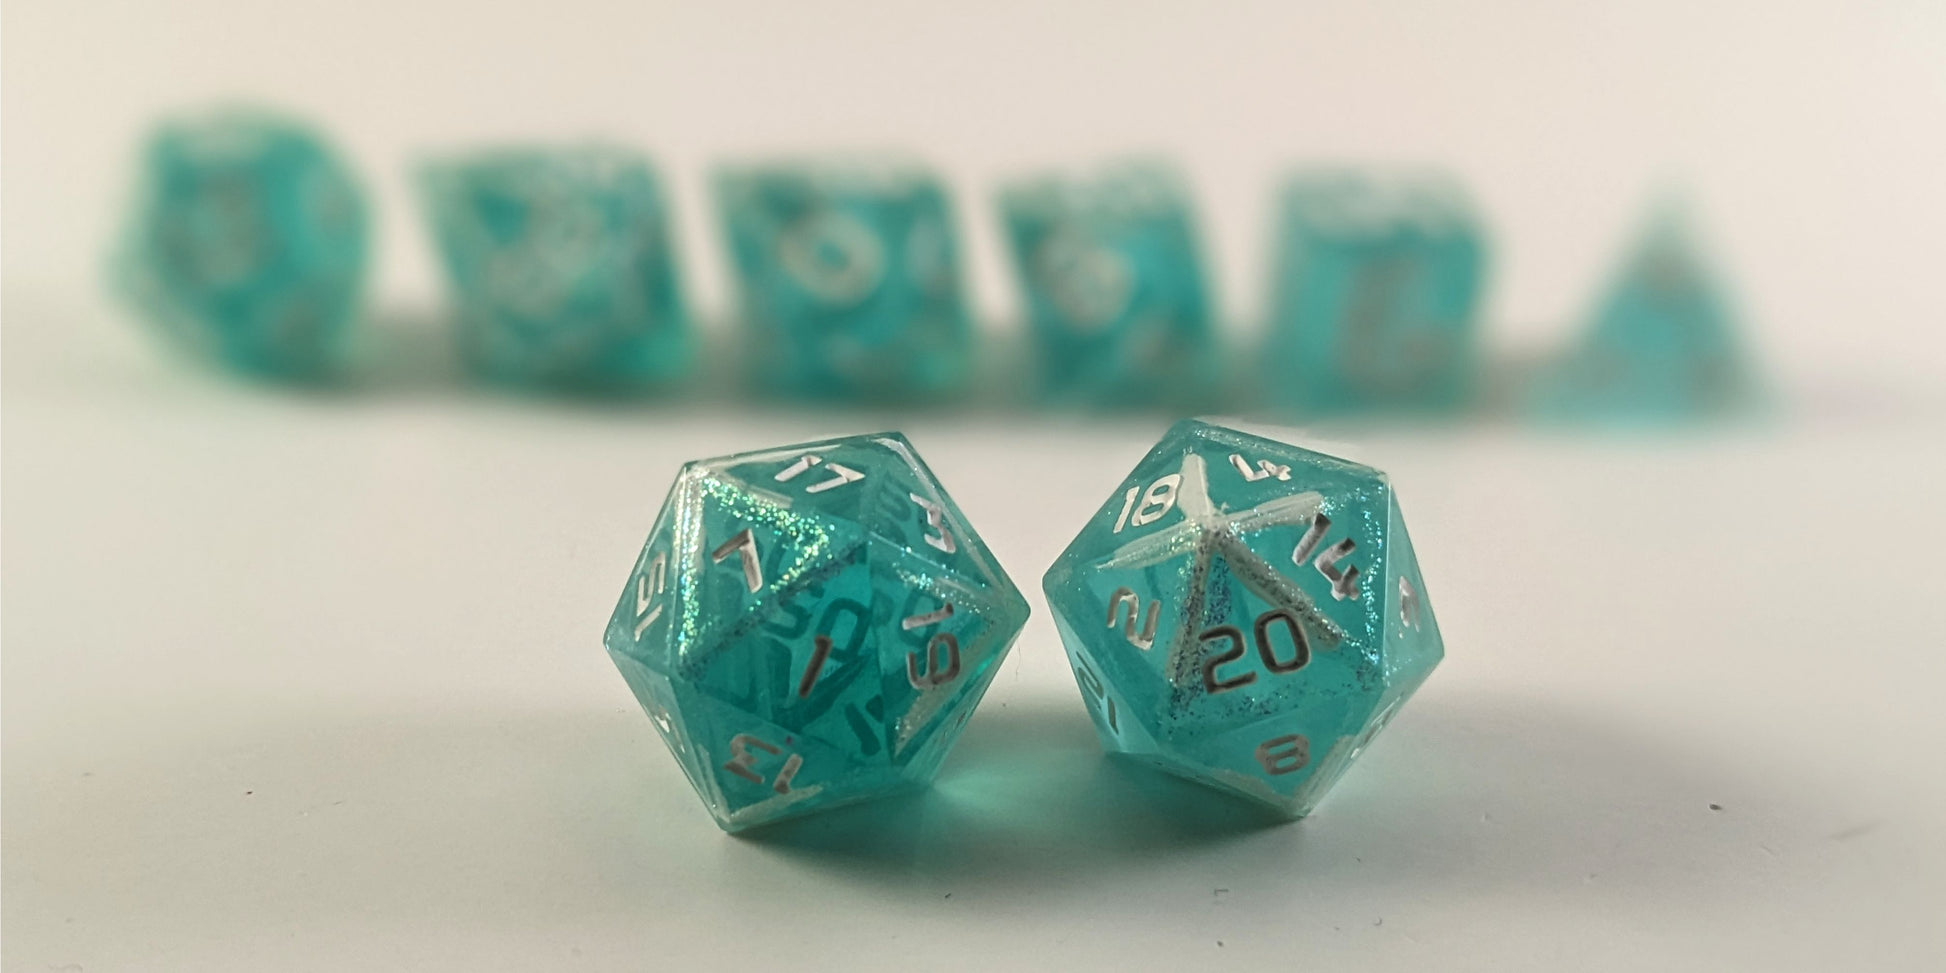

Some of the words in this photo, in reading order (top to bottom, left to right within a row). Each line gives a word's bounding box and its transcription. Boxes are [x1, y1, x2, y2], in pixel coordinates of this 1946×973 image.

[774, 455, 865, 494] 17
[1228, 454, 1292, 482] 4
[909, 492, 956, 554] 3
[1112, 474, 1181, 534] 18
[711, 528, 764, 594] 7
[1291, 512, 1360, 601] 14
[634, 551, 666, 642] 15
[1106, 586, 1161, 651] 2
[799, 634, 833, 699] 1
[902, 602, 961, 690] 19
[1199, 607, 1311, 695] 20
[723, 732, 803, 794] 13
[1253, 733, 1311, 776] 8
